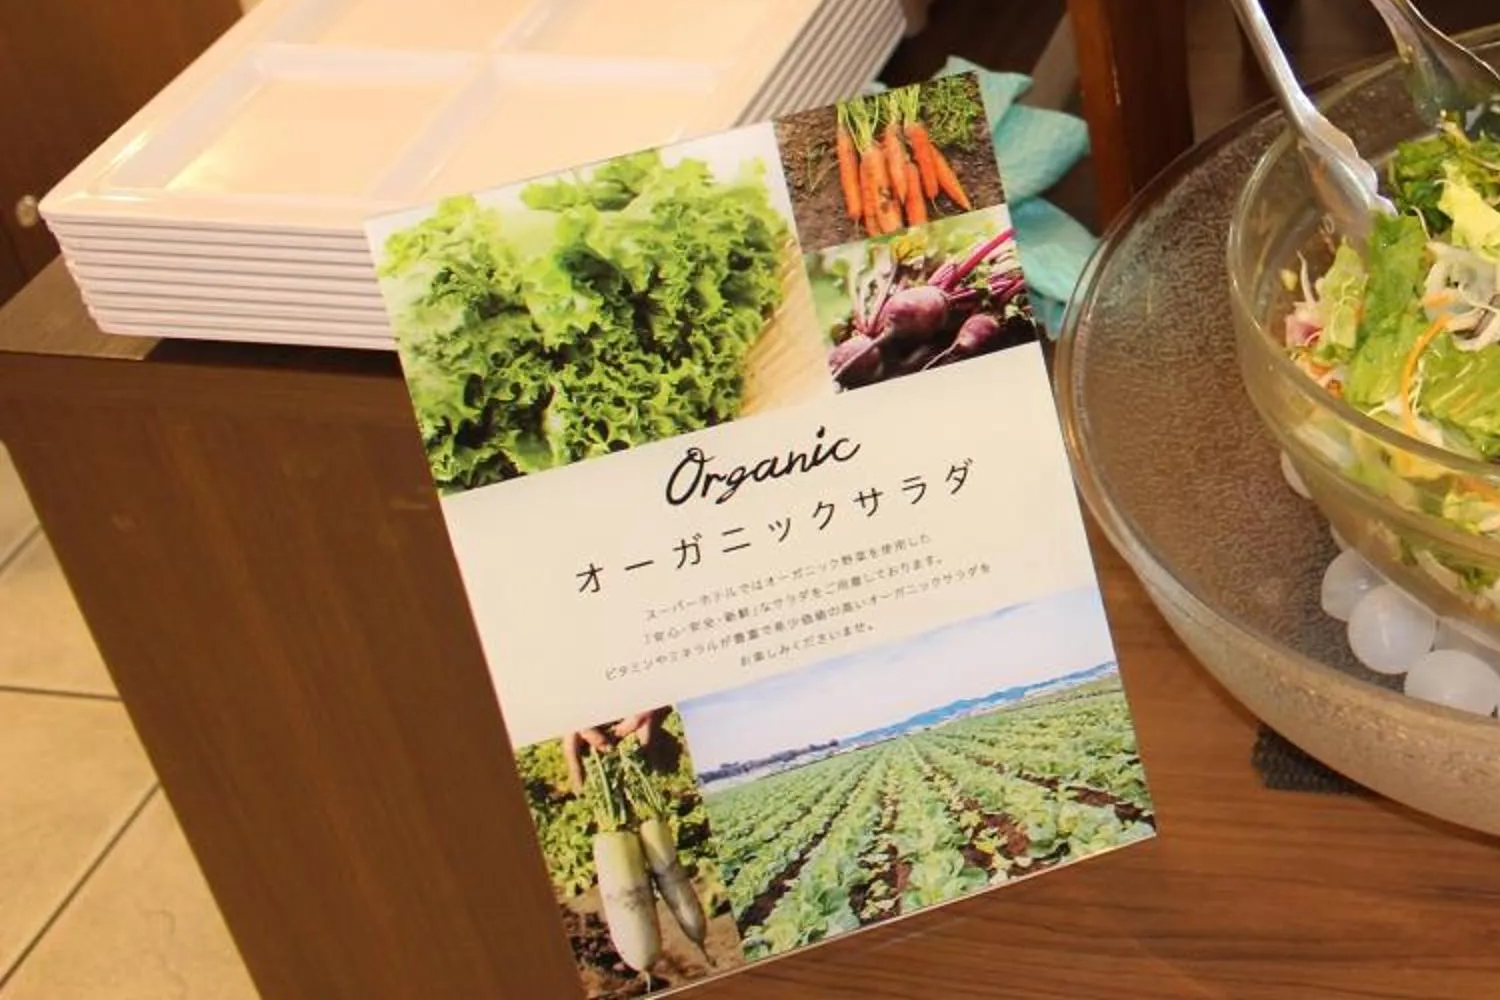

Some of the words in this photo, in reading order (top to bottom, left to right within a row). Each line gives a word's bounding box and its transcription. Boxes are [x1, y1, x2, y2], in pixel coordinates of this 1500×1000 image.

[665, 425, 861, 505] Organic
[576, 457, 974, 594] オーガニックサラダ
